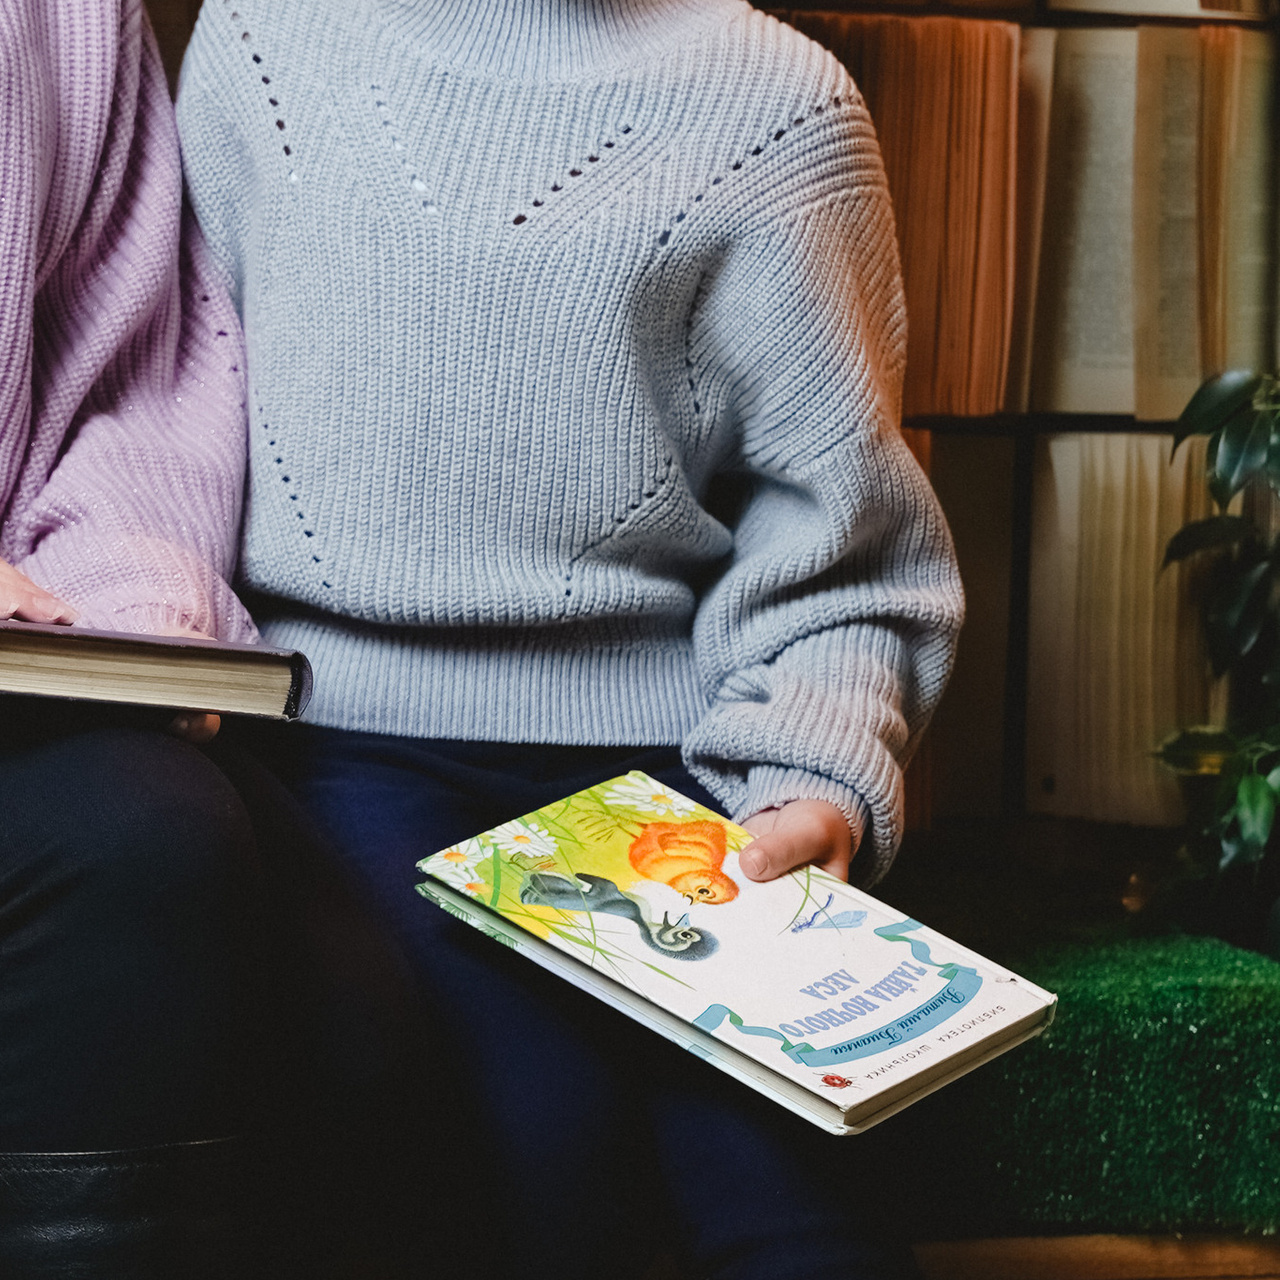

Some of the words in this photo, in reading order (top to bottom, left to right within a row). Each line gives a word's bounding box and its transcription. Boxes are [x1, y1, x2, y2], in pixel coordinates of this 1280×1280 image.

[799, 969, 860, 1000] ЛЕСА
[864, 961, 928, 1001] ТАЙНА
[779, 995, 880, 1038] НОЧНОГО
[897, 987, 965, 1032] Виталий
[938, 1005, 1006, 1043] БИБЛИОТЕКА
[831, 1027, 903, 1055] Бианки
[864, 1044, 932, 1080] ШКОЛЬНИКА
